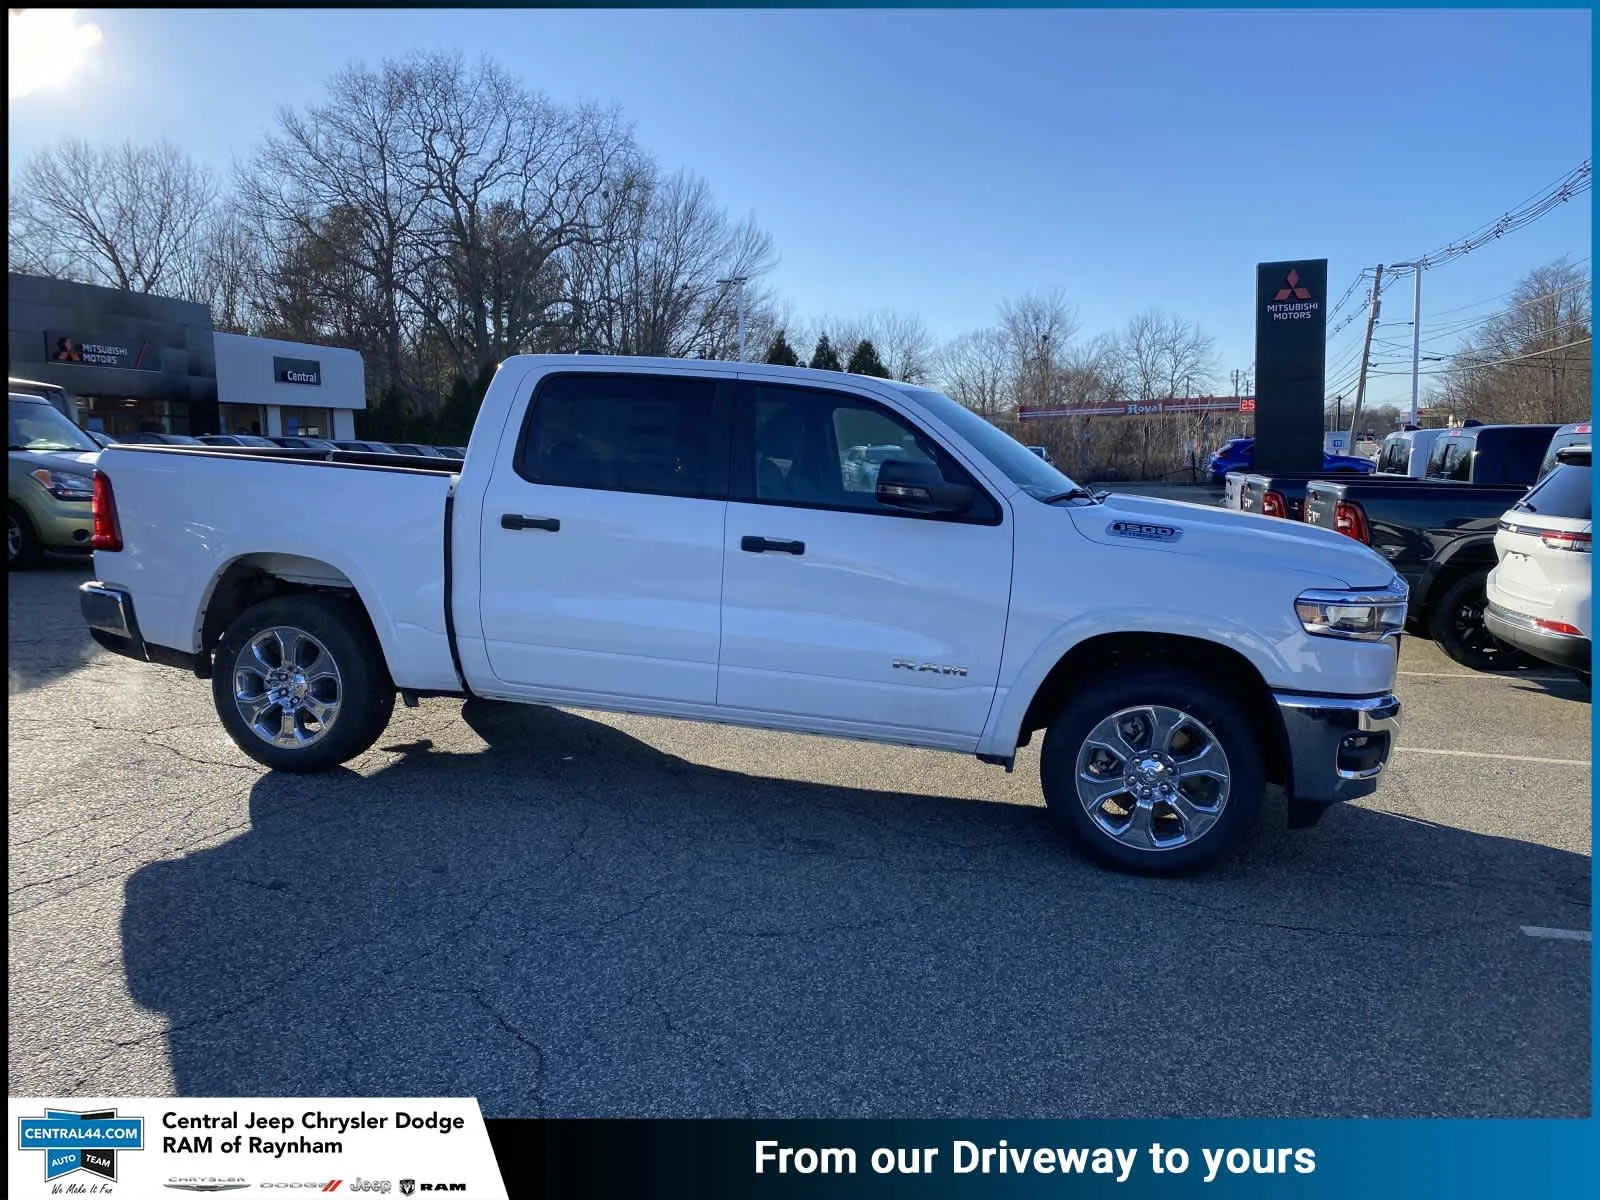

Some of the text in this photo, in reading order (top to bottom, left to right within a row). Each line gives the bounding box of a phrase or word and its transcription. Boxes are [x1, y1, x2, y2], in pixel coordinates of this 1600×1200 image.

[1267, 303, 1318, 312] MITSUBISHI
[1273, 311, 1311, 320] MOTORS
[82, 343, 128, 356] MITSUBISHI
[82, 353, 118, 365] MOTORS
[287, 370, 317, 383] Central
[892, 659, 967, 677] RAM
